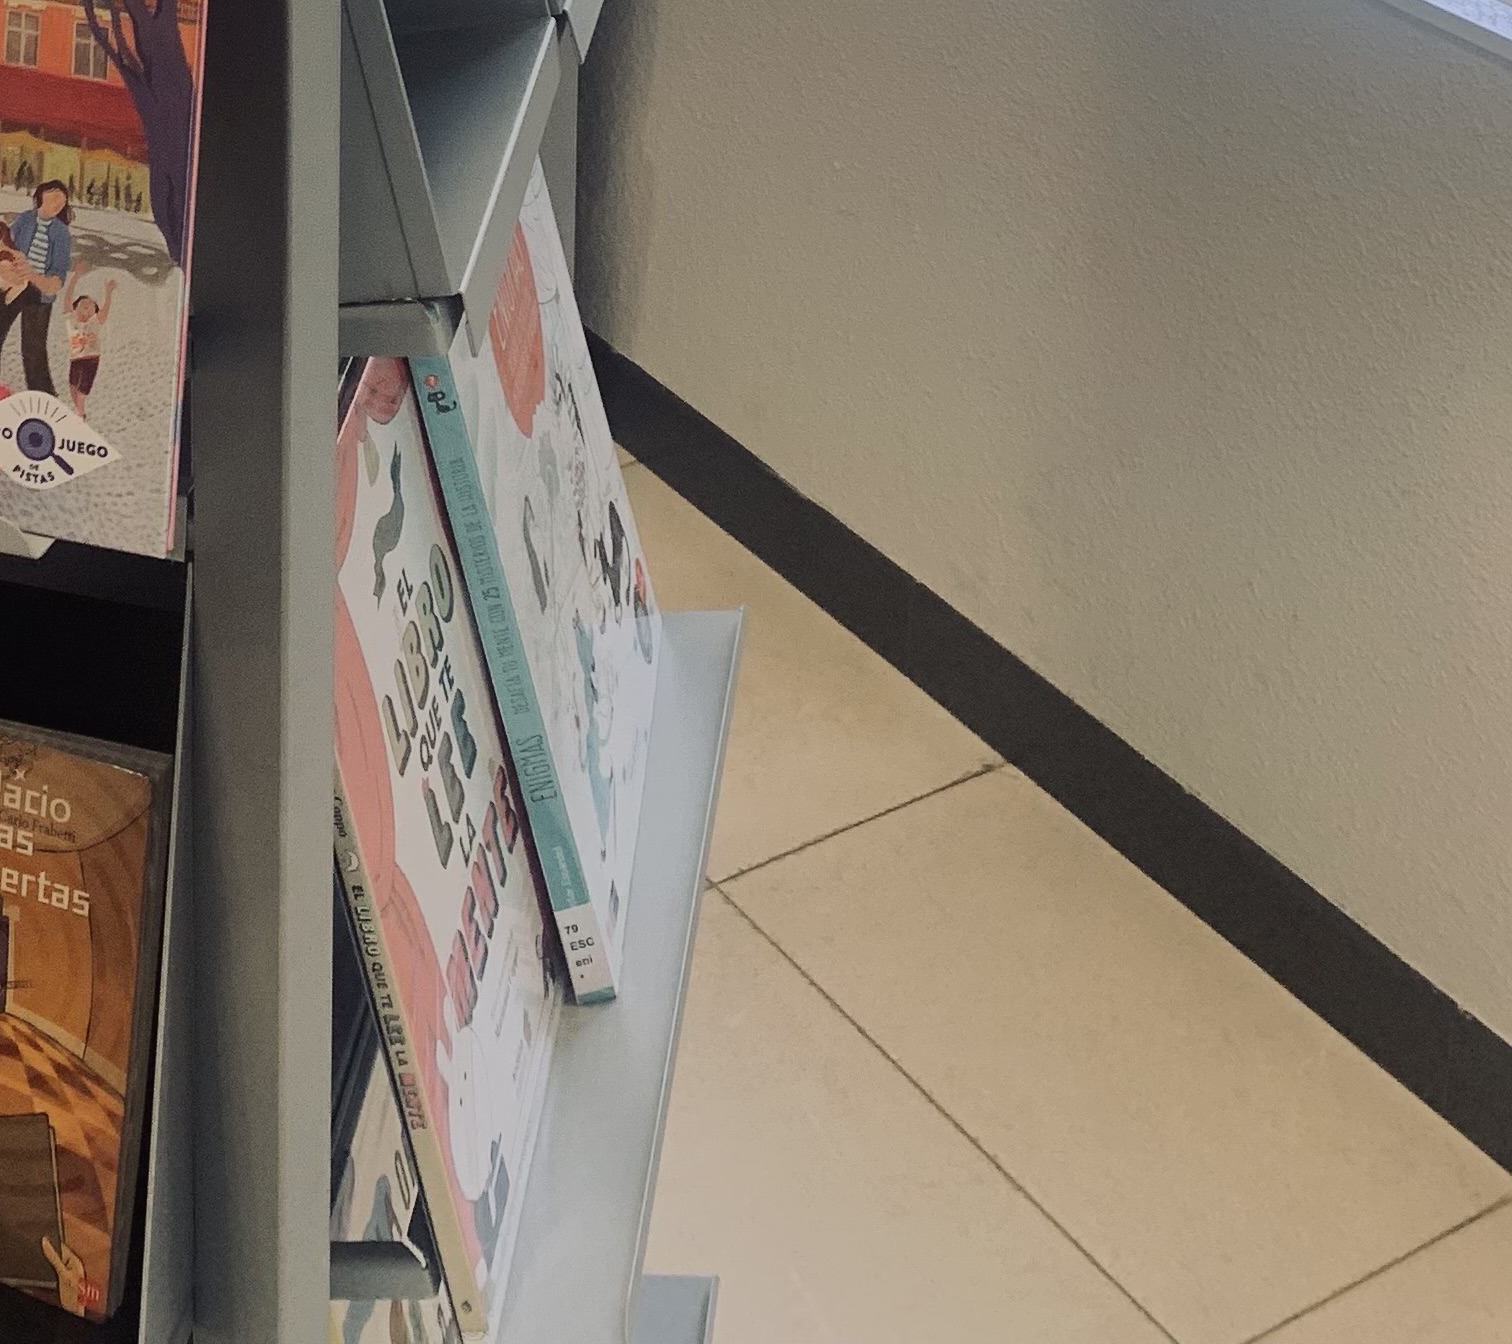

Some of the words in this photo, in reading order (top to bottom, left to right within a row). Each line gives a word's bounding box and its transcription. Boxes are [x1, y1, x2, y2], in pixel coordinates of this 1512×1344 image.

[11, 463, 56, 485] PISTAS
[57, 438, 109, 459] JUEGO
[396, 567, 414, 617] EL
[481, 585, 501, 602] 25
[381, 543, 455, 778] LIBRO
[419, 694, 443, 772] QUE
[438, 654, 455, 703] TE
[423, 686, 478, 871] LEE
[515, 733, 558, 804] ENIGMAS
[459, 812, 477, 869] LA
[445, 764, 519, 1034] MENTE
[563, 924, 579, 935] 79
[351, 884, 366, 901] EL
[371, 961, 389, 990] QUE
